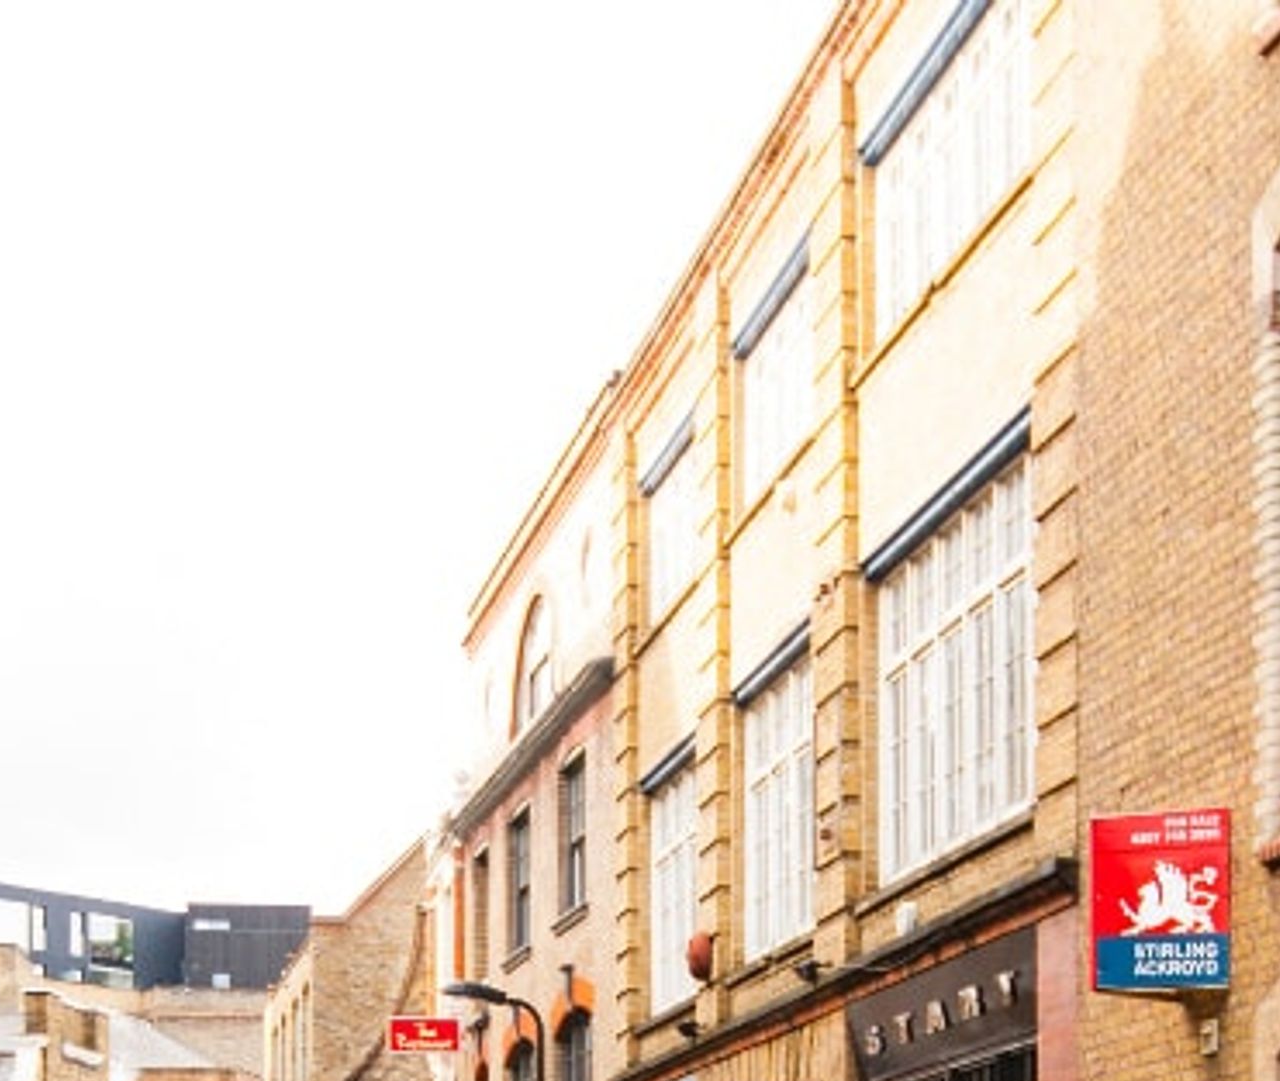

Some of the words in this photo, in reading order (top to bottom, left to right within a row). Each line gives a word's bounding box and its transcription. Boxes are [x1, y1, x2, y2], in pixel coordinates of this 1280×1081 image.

[1133, 941, 1218, 958] STIRLING
[1133, 960, 1218, 977] ACKROYD
[865, 970, 1016, 1056] START
